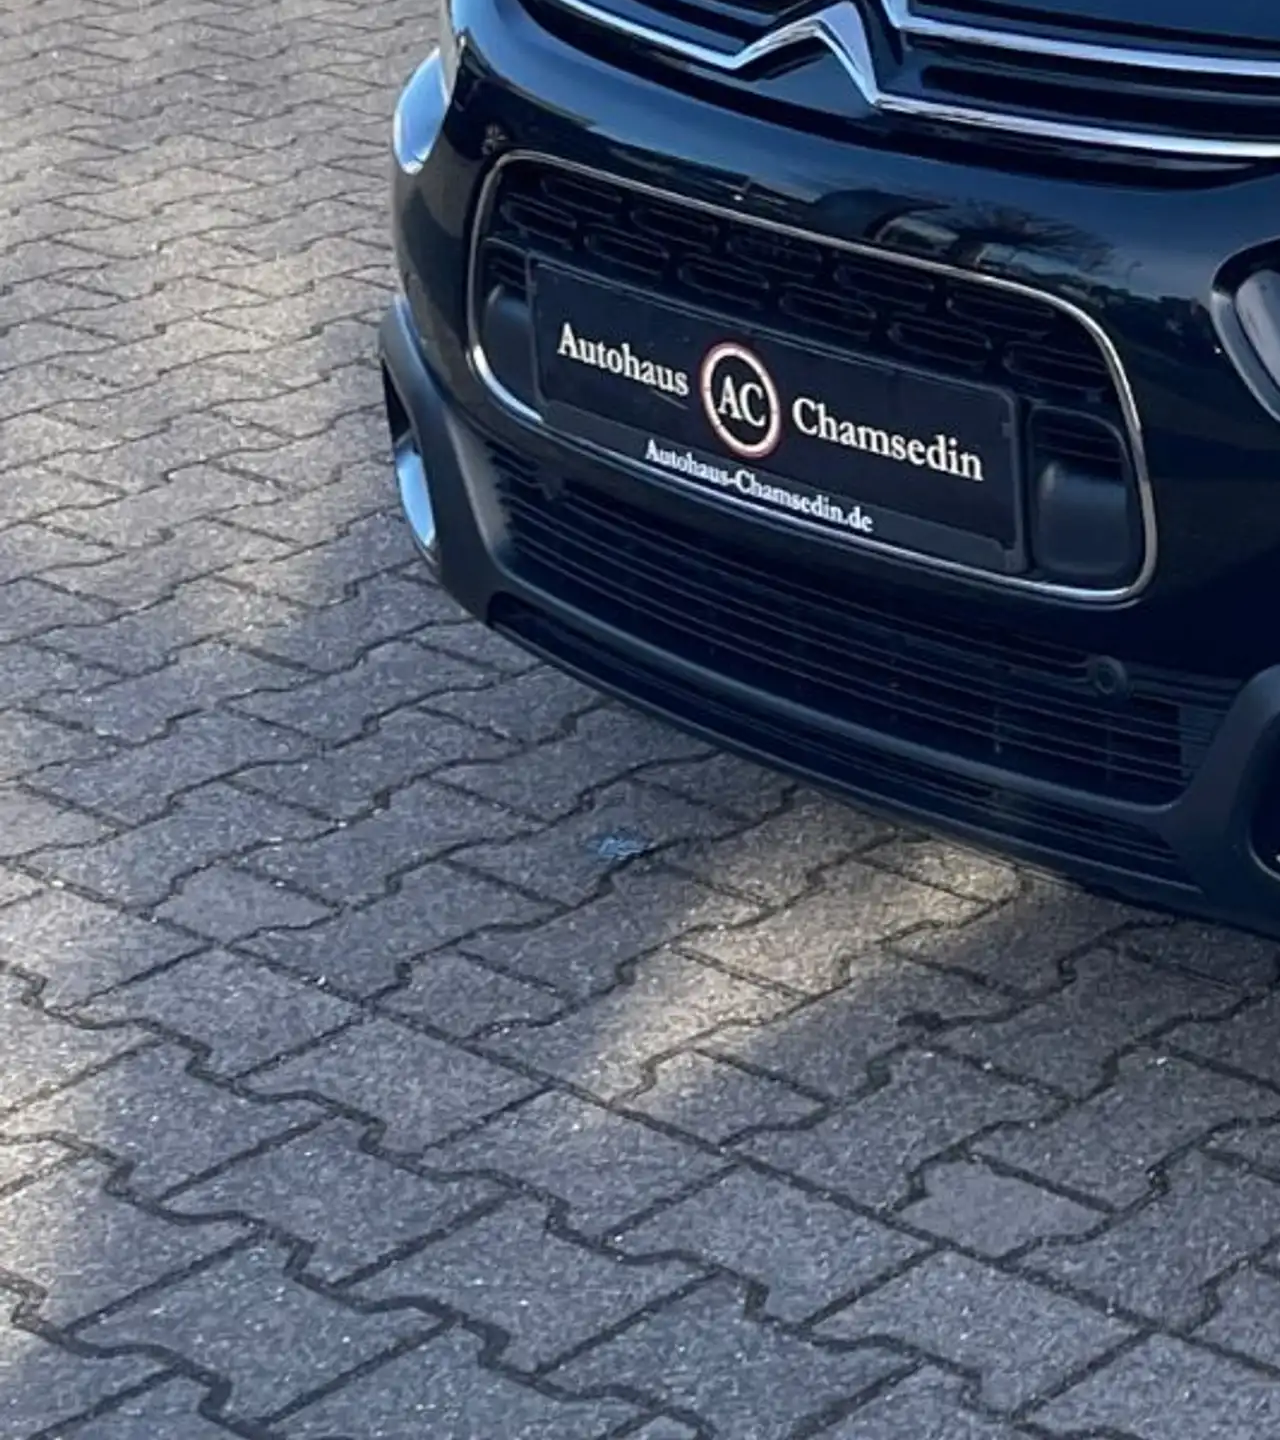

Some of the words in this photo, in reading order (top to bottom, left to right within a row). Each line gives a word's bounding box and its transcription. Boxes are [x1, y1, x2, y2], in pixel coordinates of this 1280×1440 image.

[557, 322, 690, 398] Autohaus
[717, 375, 767, 428] AC
[792, 396, 985, 482] Chamsedin
[644, 438, 874, 534] Autohaus-Chamsedin.de
